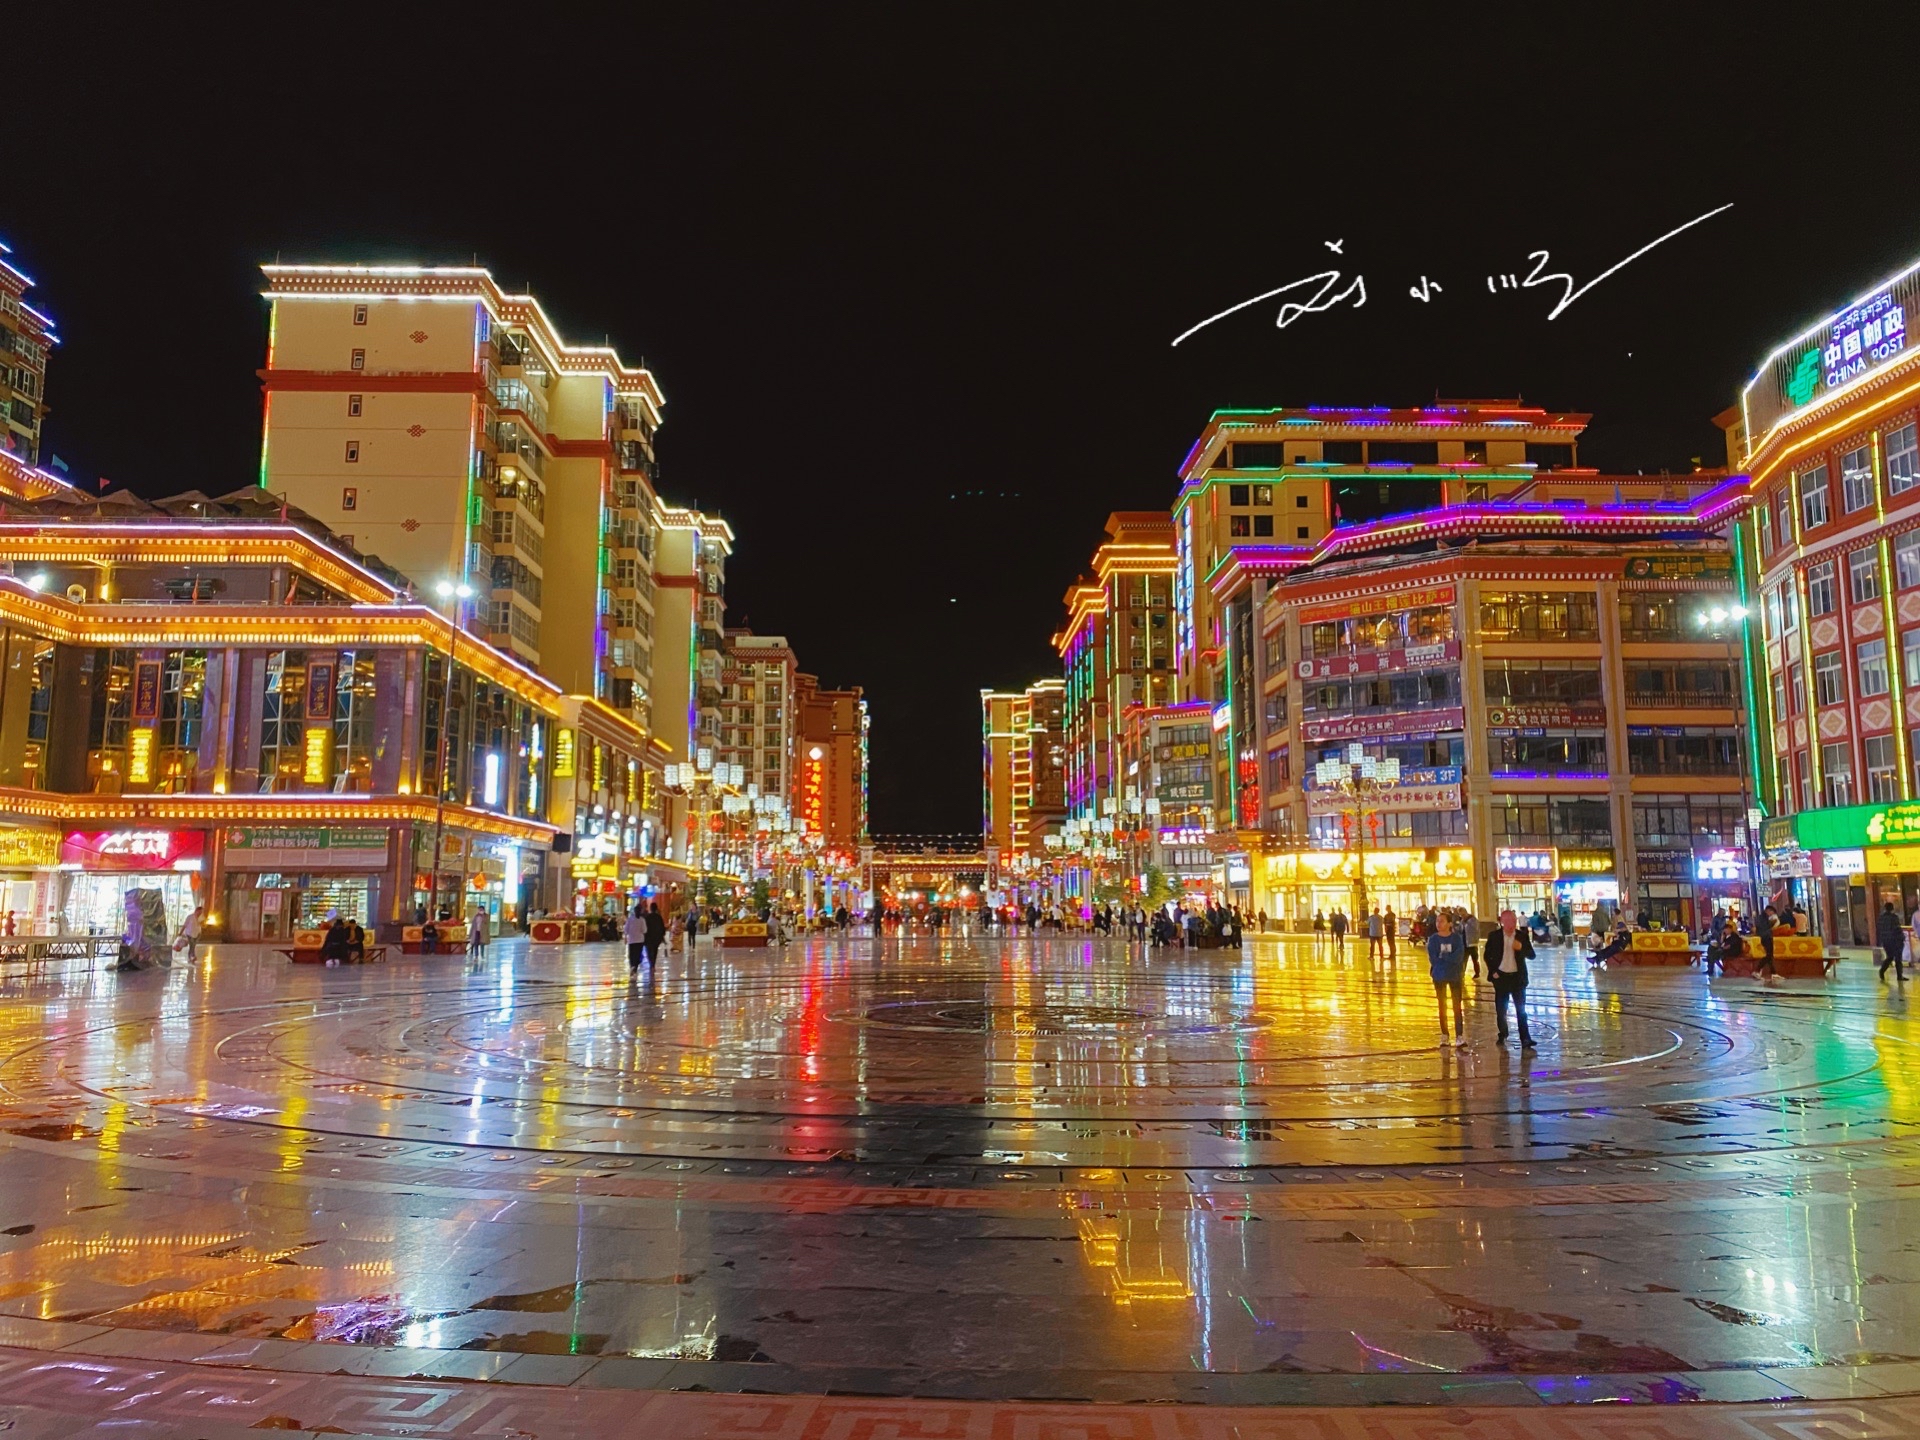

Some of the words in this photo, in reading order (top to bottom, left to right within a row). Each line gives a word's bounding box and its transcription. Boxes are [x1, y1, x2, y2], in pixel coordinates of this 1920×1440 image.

[1825, 306, 1904, 368] 中国邮政
[1827, 357, 1866, 387] CHINA
[1871, 333, 1904, 359] POST
[1320, 658, 1389, 676] 维纳斯
[1440, 770, 1455, 781] 3F
